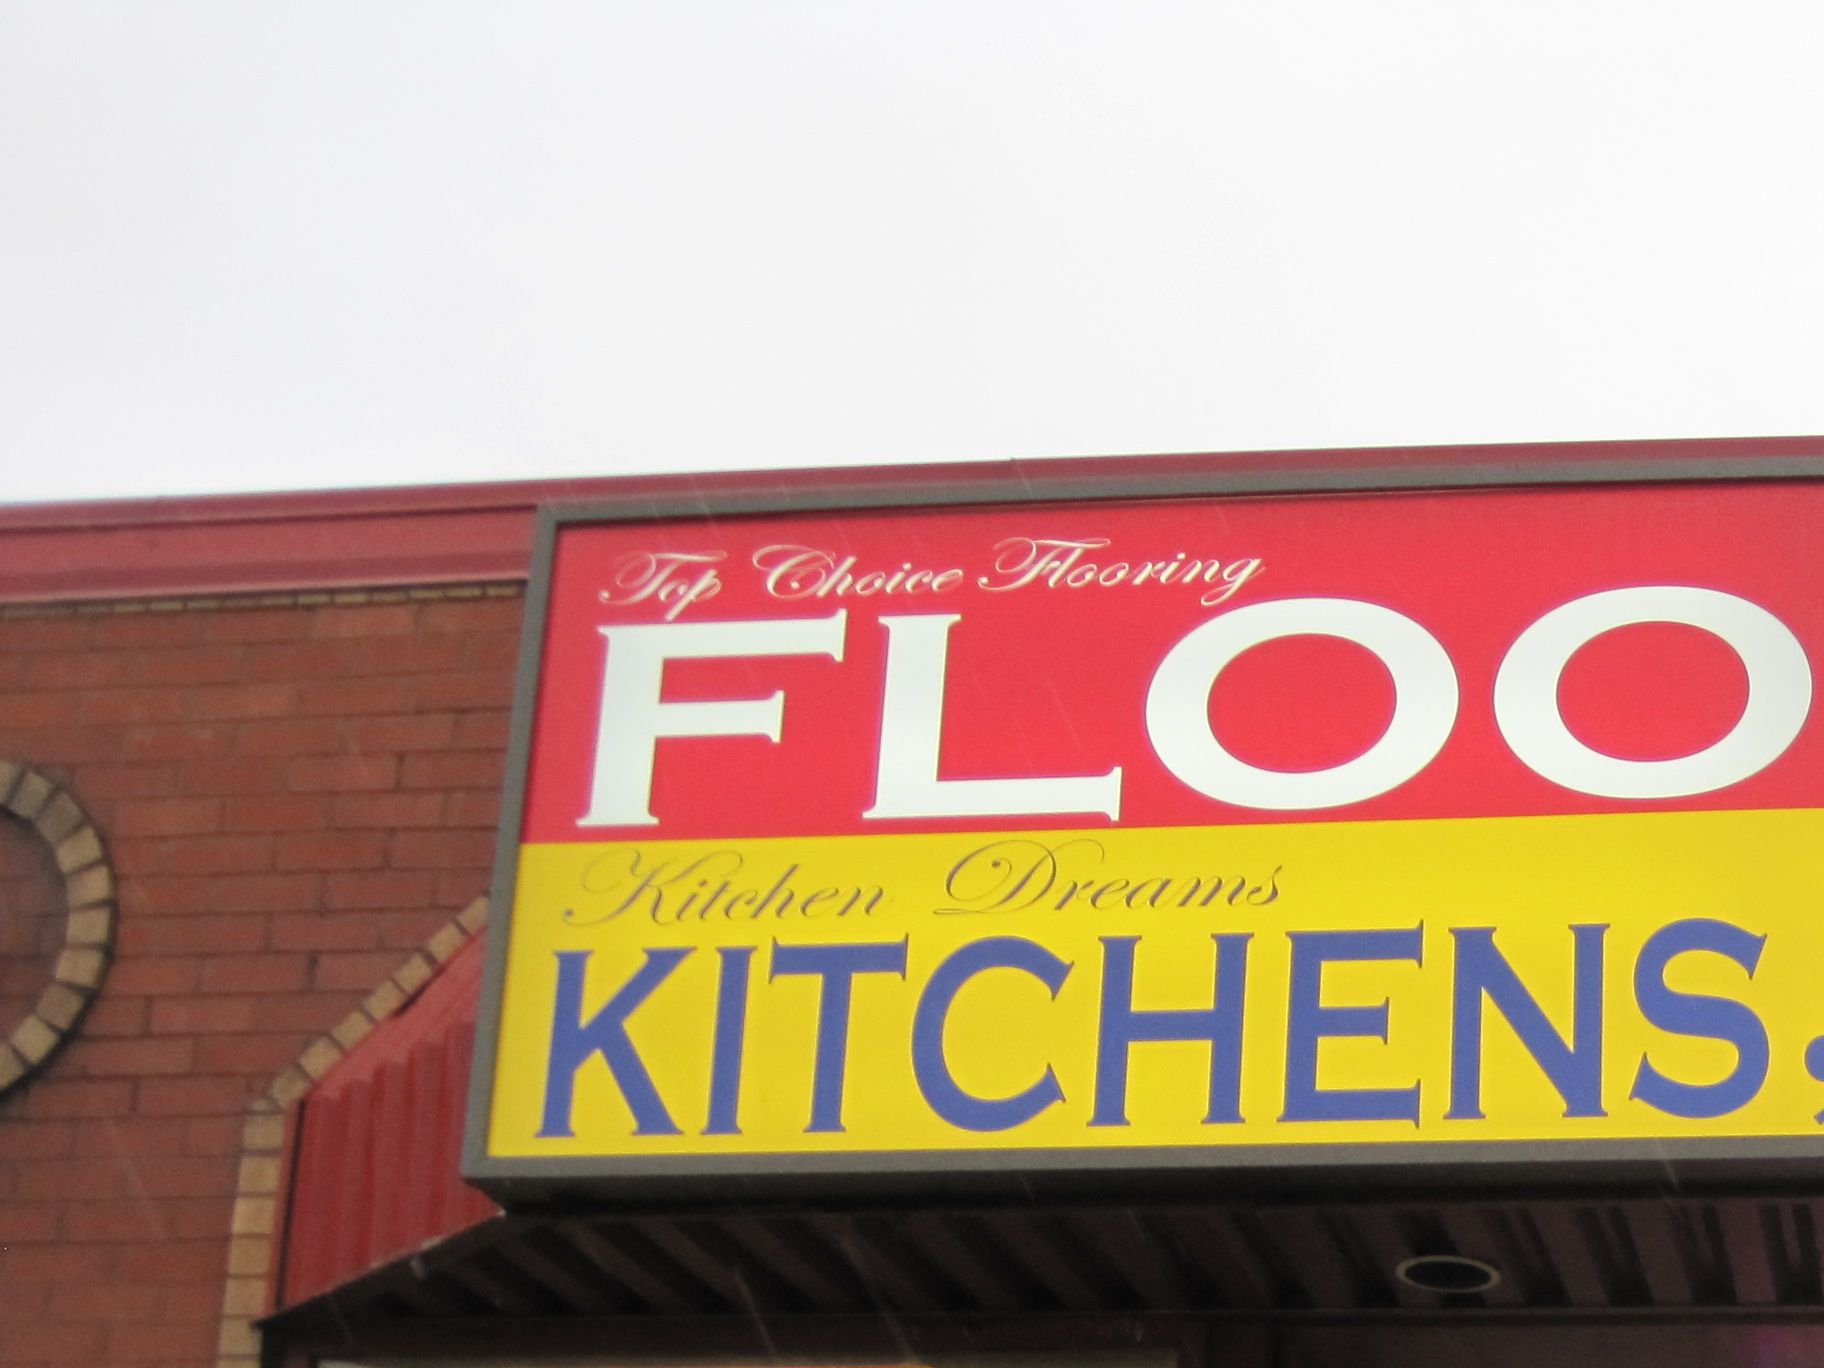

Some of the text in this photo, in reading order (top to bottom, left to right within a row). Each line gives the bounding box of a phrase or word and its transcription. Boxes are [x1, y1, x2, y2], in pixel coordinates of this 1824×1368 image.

[600, 537, 1266, 621] Top Choice Flooring
[561, 838, 1283, 926] Kitchen Dreams
